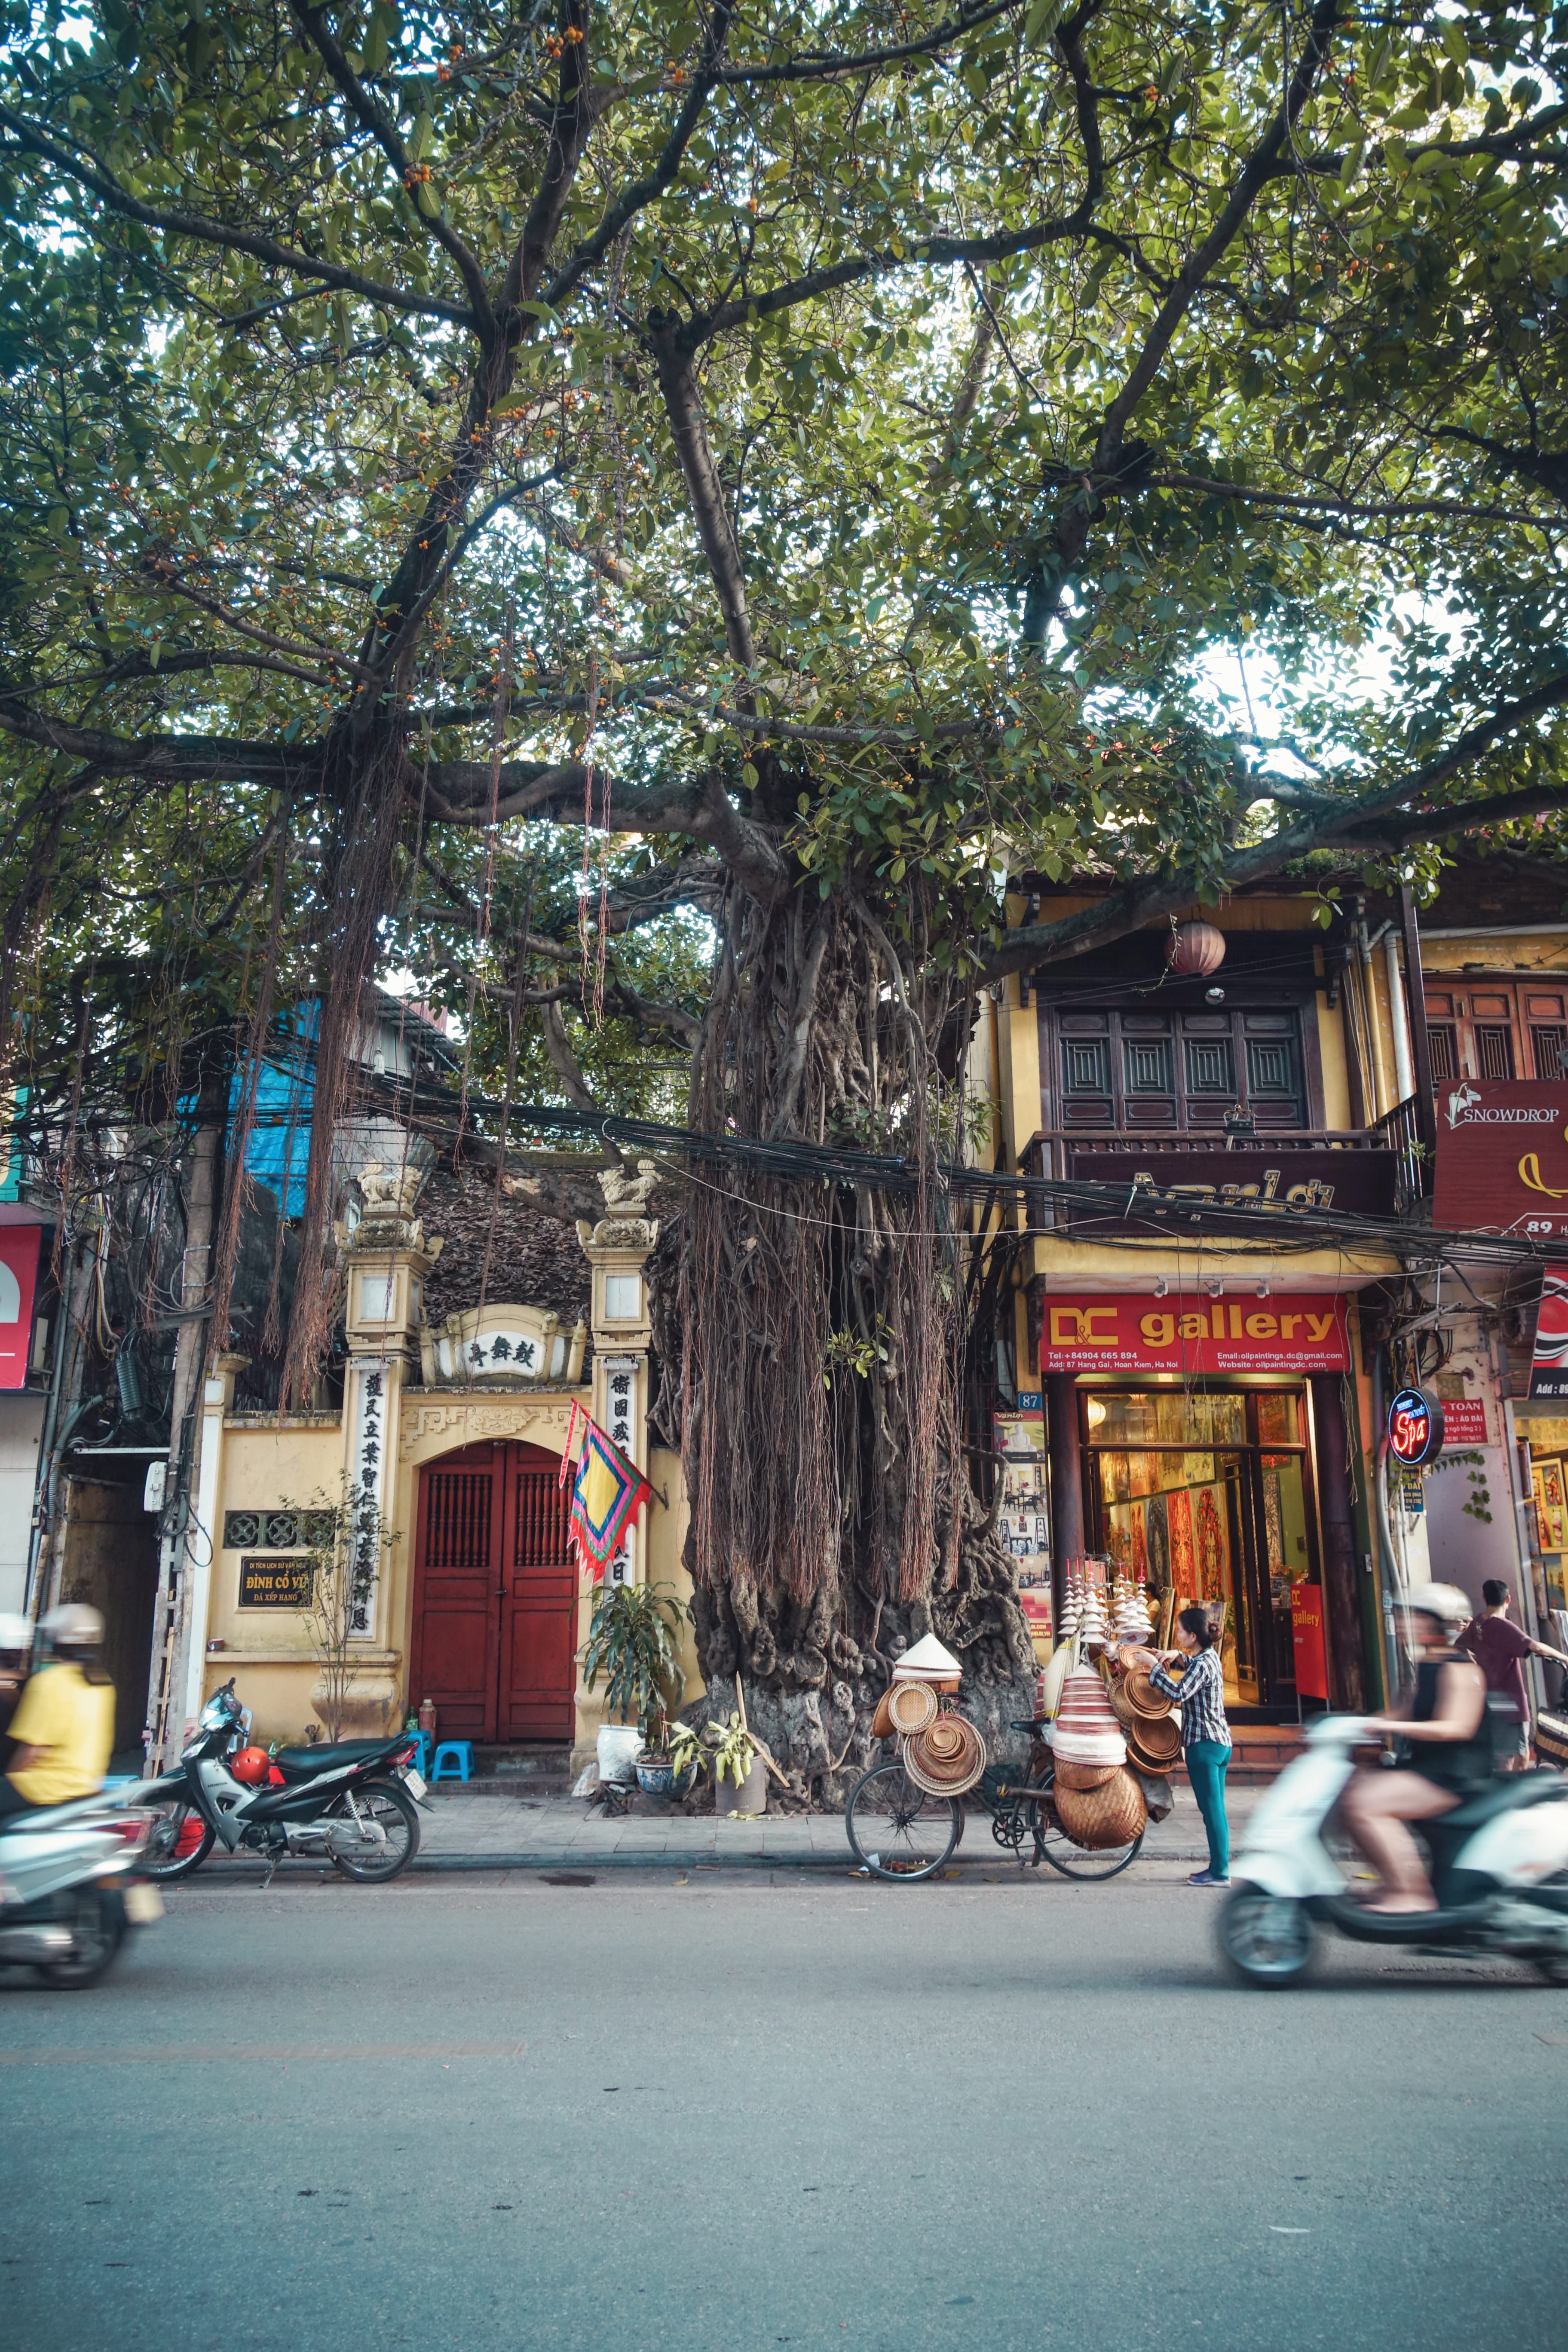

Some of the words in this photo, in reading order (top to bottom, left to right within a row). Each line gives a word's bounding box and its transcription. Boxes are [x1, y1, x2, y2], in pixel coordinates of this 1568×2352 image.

[1464, 1109, 1559, 1121] SNOWDROP
[1527, 1221, 1552, 1233] 89
[1561, 1225, 1568, 1234] H
[1140, 1305, 1335, 1348] gallery
[1256, 1361, 1326, 1369] oilpaintingdc.com
[1440, 1378, 1461, 1396] 89
[1536, 1384, 1553, 1394] Add
[1023, 1395, 1037, 1407] 87
[1449, 1402, 1481, 1410] TOÀN
[1393, 1413, 1426, 1455] Spa
[246, 1573, 273, 1589] ĐÌNH
[275, 1570, 290, 1589] CỔ
[264, 1591, 278, 1601] XẾP
[279, 1594, 297, 1602] HẠNG
[1293, 1610, 1319, 1627] gallery
